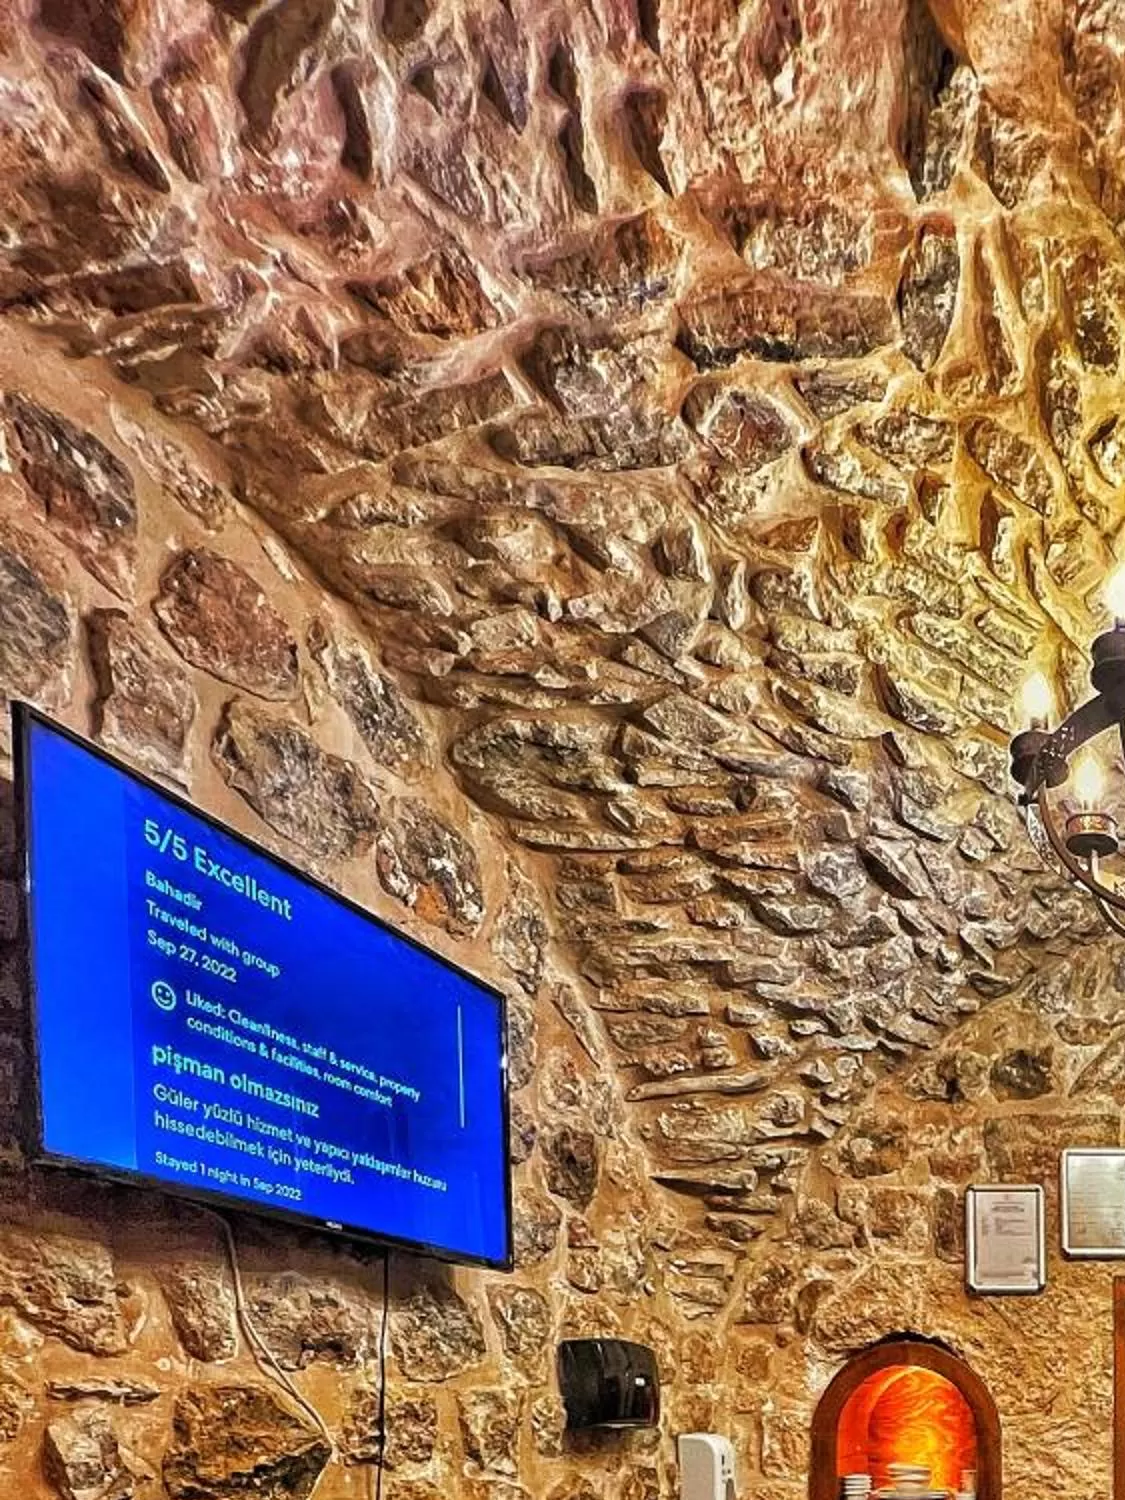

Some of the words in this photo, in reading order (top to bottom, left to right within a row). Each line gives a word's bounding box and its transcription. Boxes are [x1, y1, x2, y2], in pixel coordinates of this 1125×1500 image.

[144, 818, 188, 861] 5/5
[193, 846, 293, 921] Excellent
[146, 899, 207, 941] Traveled
[210, 933, 240, 958] with
[242, 951, 281, 979] group
[147, 929, 177, 957] Sep
[201, 954, 237, 983] 2022
[152, 1043, 225, 1084] pişman
[229, 1073, 320, 1118] olmazsınız
[185, 989, 227, 1019] Liked:
[302, 1043, 327, 1061] staff
[329, 1051, 339, 1066] &
[379, 1075, 421, 1103] property
[187, 1017, 257, 1053] conditions
[259, 1042, 269, 1059] &
[323, 1072, 352, 1091] room
[153, 1083, 199, 1111] Güler
[203, 1103, 243, 1127] yüzlü
[246, 1113, 293, 1142] hizmet
[295, 1133, 311, 1148] ve
[154, 1110, 265, 1157] hissedebilmek
[267, 1144, 291, 1166] için
[155, 1151, 197, 1174] Stayed
[199, 1162, 205, 1176] 1
[207, 1166, 239, 1186] night
[240, 1173, 251, 1187] in
[253, 1177, 274, 1196] Sep
[275, 1184, 303, 1201] 2022
